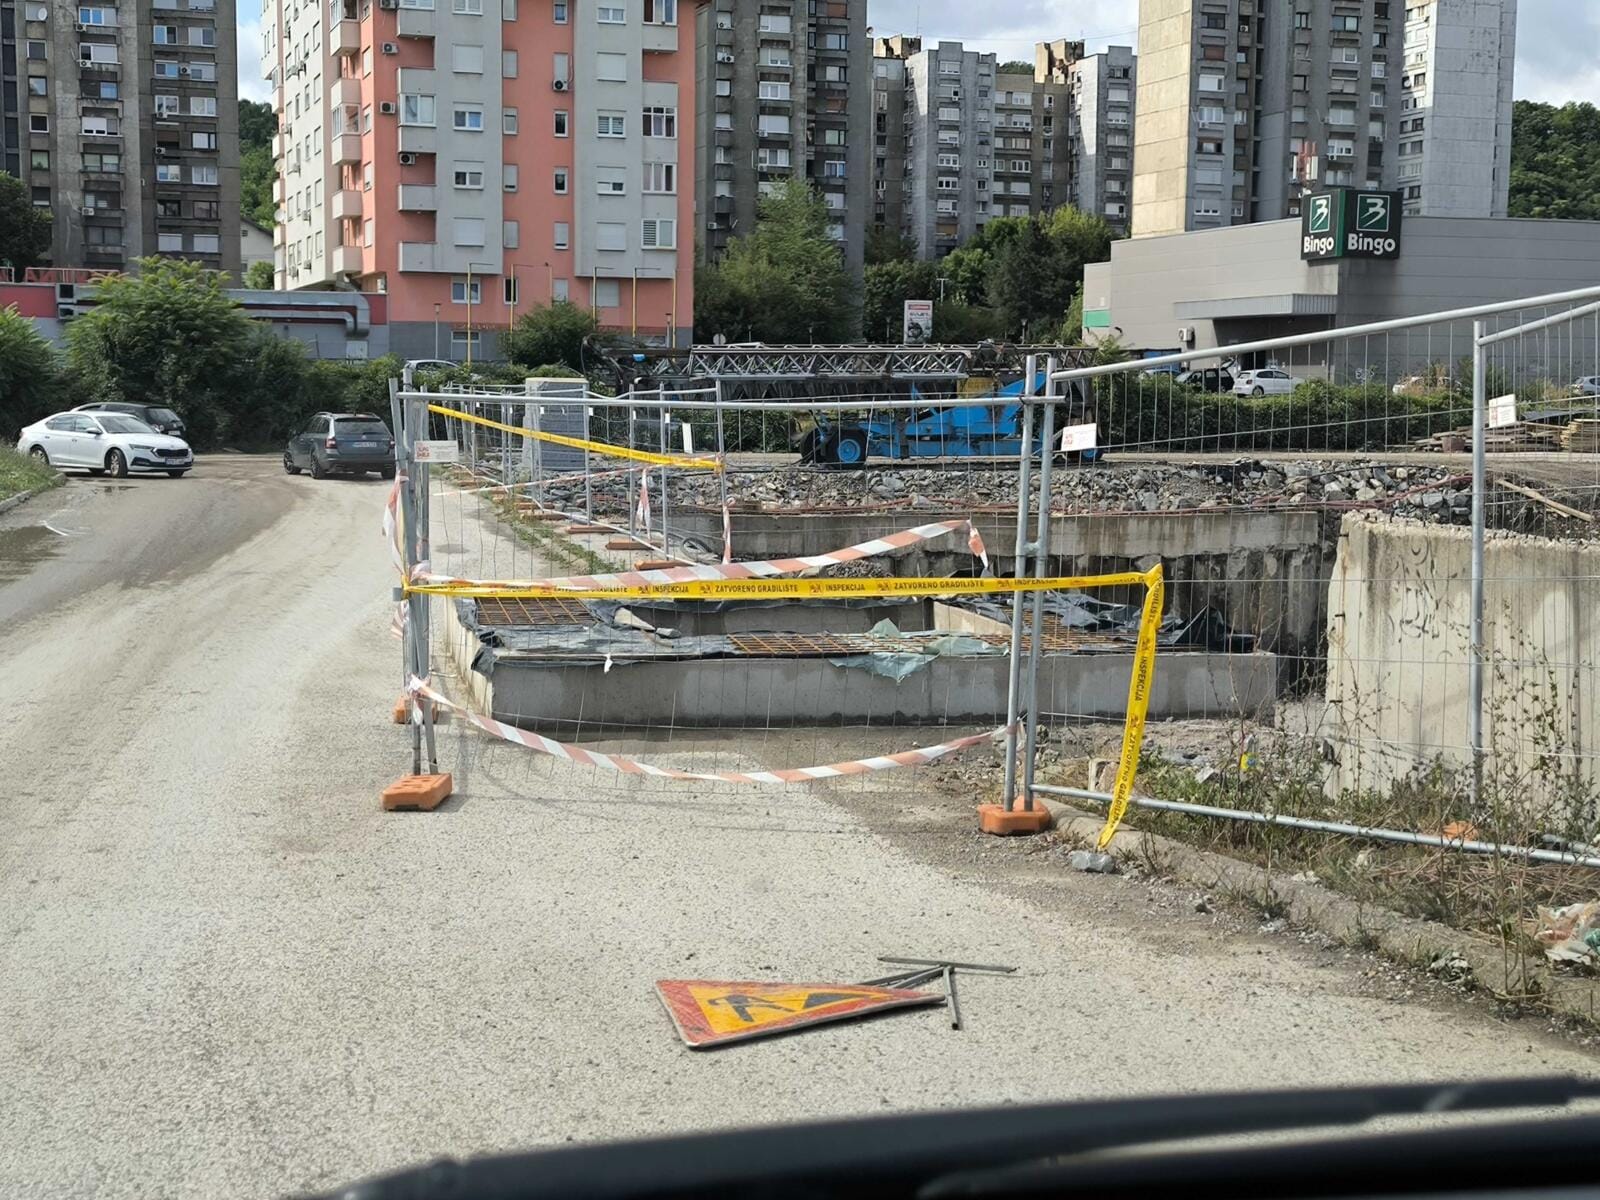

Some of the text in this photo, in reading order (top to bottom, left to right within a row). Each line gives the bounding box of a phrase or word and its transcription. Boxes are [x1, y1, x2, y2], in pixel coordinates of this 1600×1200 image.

[1303, 235, 1334, 255] Bingo
[1347, 233, 1396, 255] Bingo
[652, 585, 689, 593] INSPEKCIJA
[715, 584, 756, 593] ZATVORENO
[825, 583, 866, 592] INSPEKCIJA
[894, 581, 938, 590] ZATVORENO
[1135, 656, 1147, 701] INSPEKCIJA
